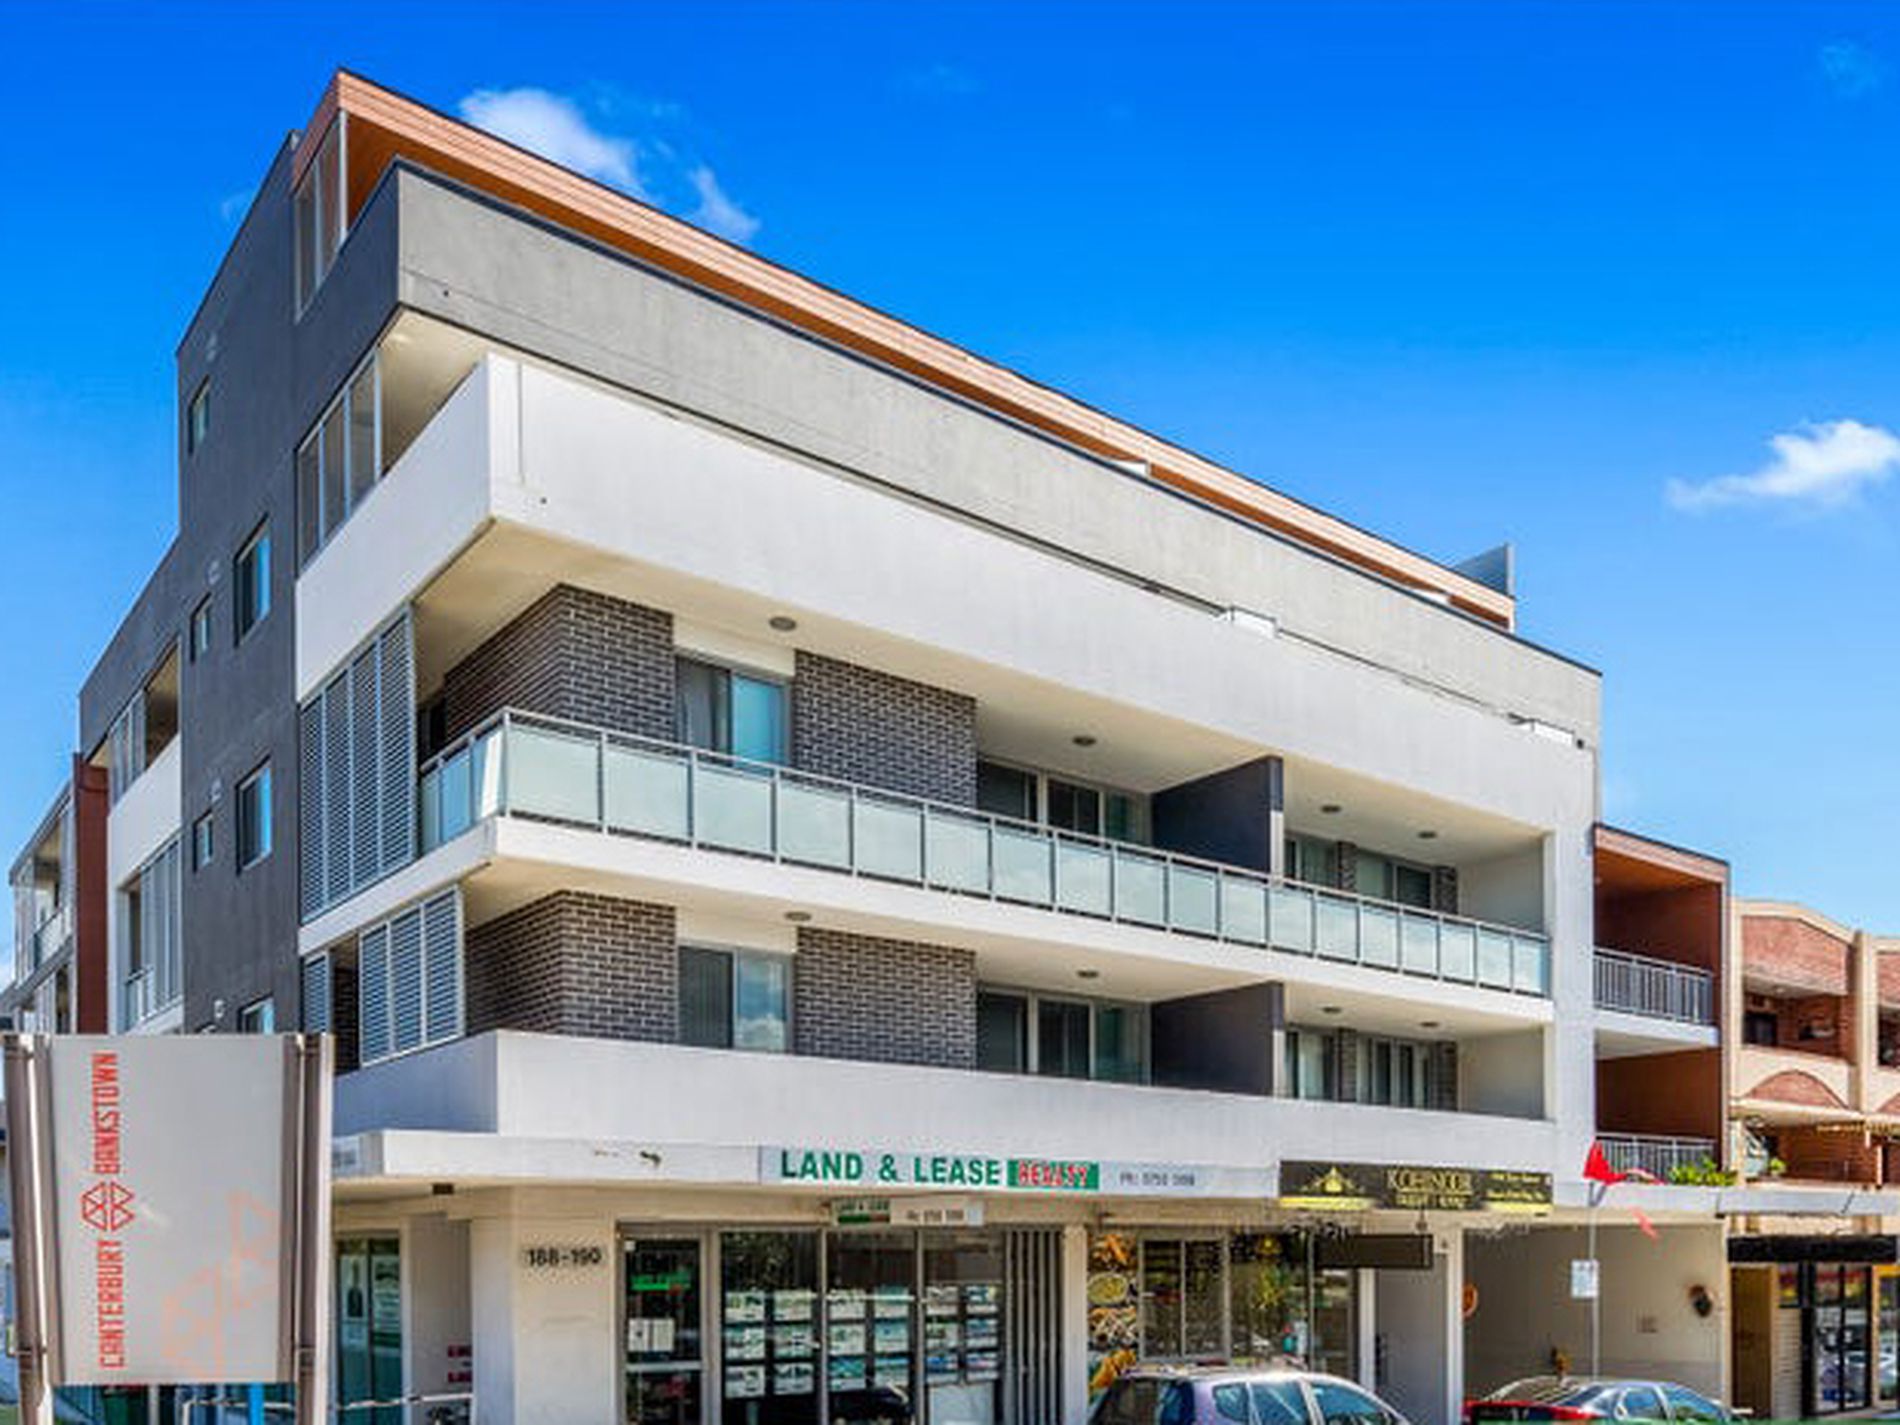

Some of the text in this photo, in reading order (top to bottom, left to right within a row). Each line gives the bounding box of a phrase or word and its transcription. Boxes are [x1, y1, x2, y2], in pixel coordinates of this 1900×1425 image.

[781, 1150, 863, 1180] LAND
[879, 1154, 898, 1182] &
[914, 1157, 1001, 1186] LEASE
[92, 1053, 124, 1369] CANTERBURY BANKSTOWN
[528, 1247, 602, 1267] 188-190
